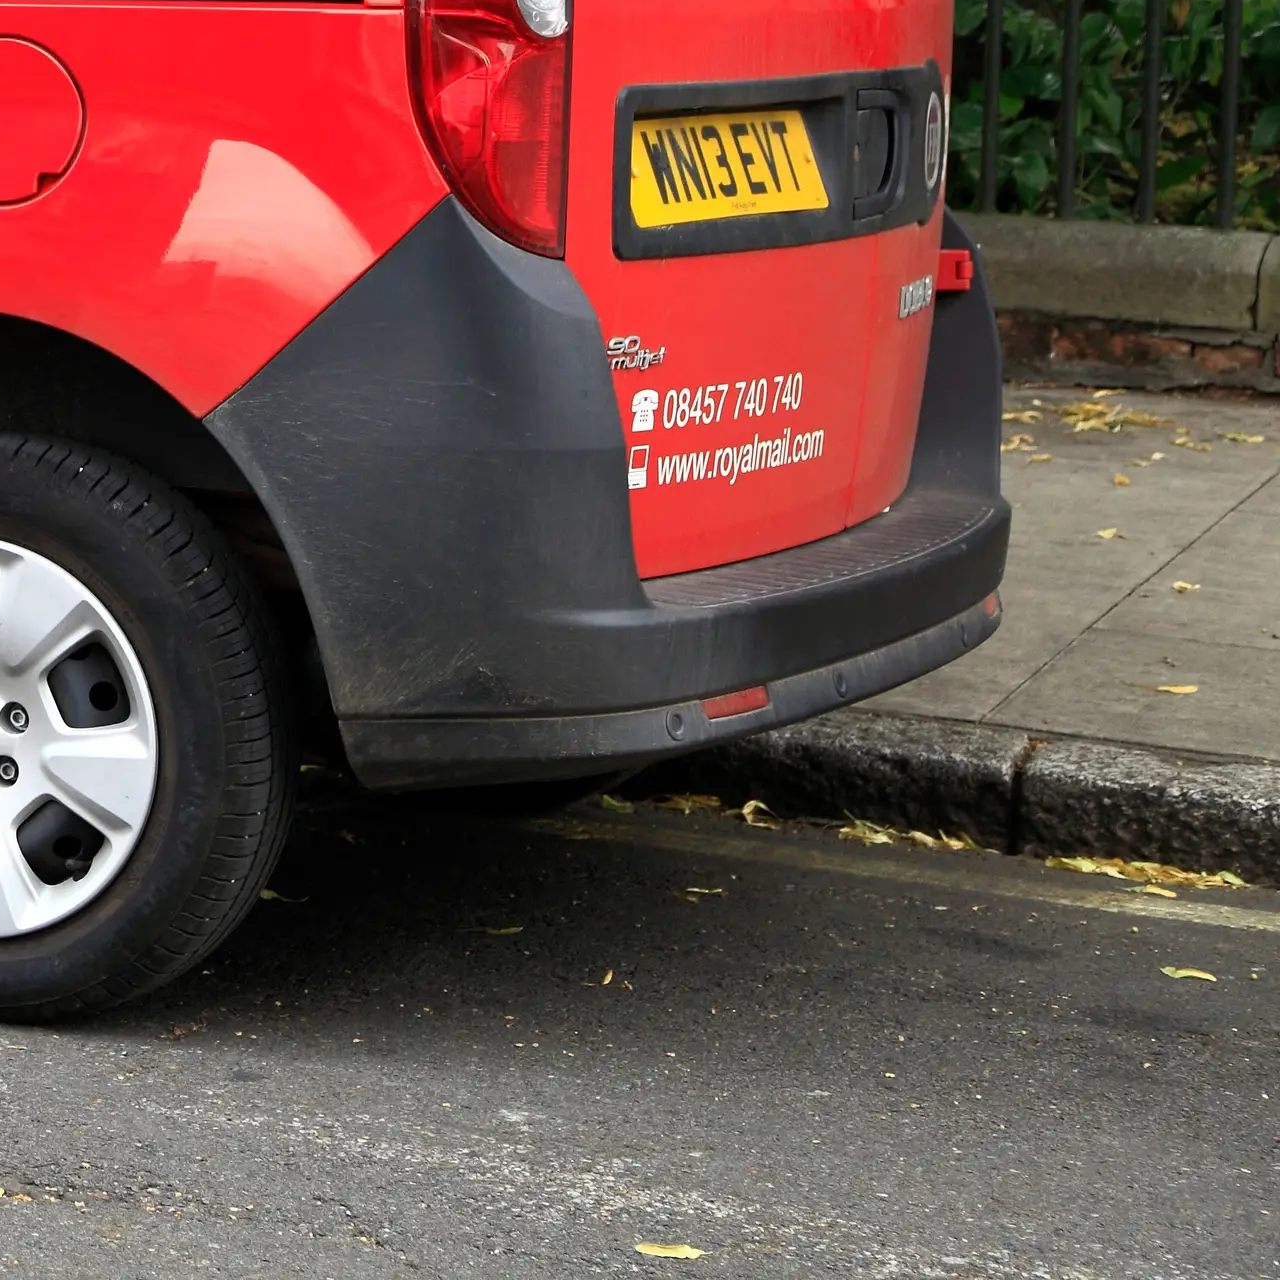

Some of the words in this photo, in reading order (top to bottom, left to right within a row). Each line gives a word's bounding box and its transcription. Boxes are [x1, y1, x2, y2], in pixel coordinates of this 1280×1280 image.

[641, 125, 738, 205] WN13
[729, 121, 801, 195] EVT
[663, 384, 729, 429] 08457
[733, 377, 768, 420] 740
[772, 372, 803, 413] 740
[657, 427, 825, 486] www.royalmail.com
